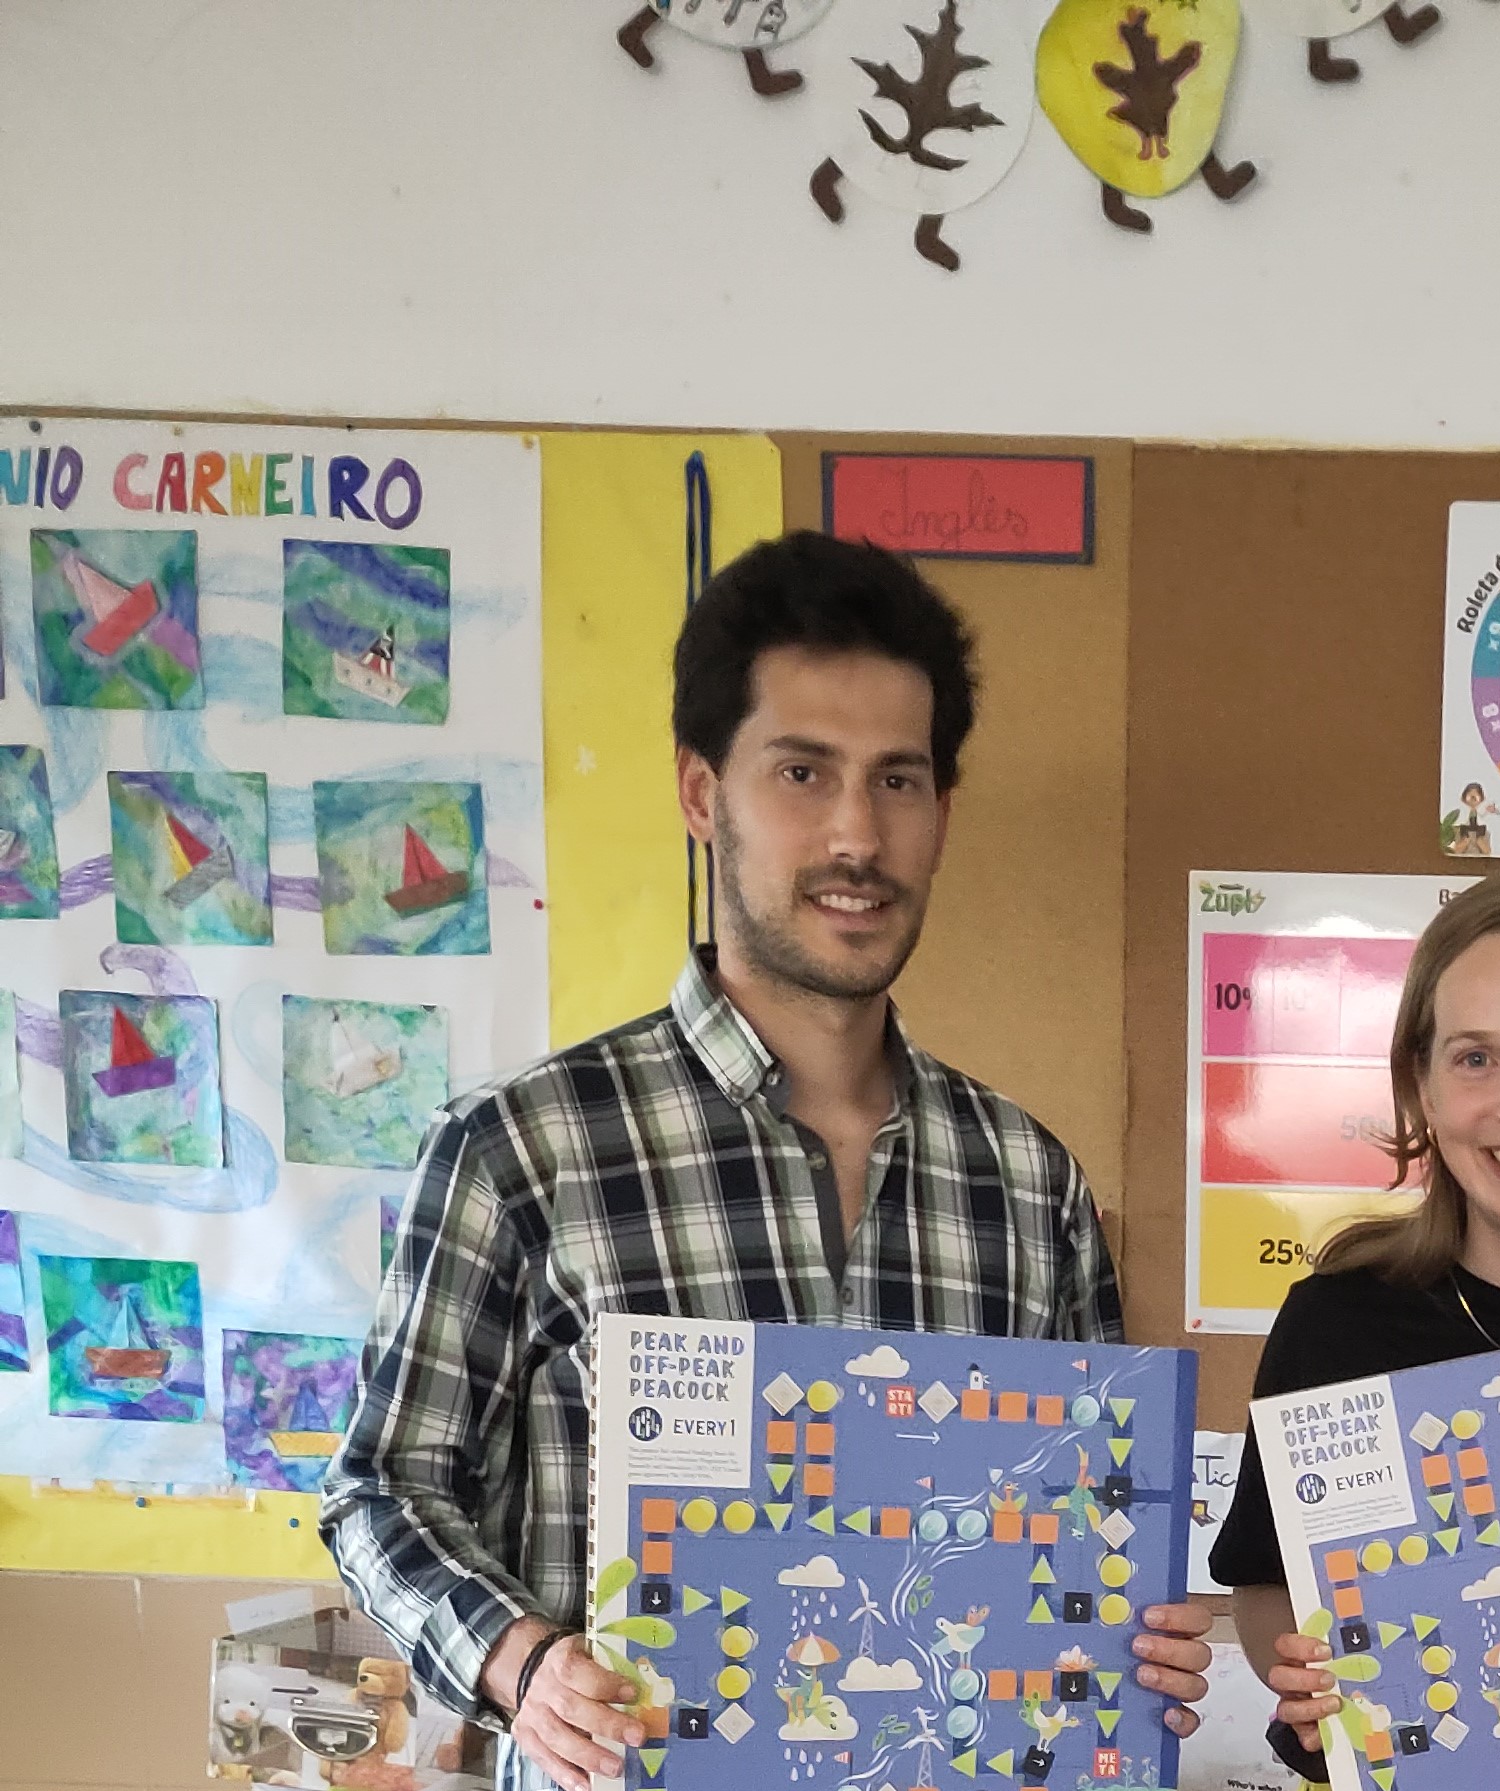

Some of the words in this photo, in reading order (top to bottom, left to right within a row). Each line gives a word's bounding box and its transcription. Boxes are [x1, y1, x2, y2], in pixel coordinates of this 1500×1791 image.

[113, 449, 422, 530] CARNEIRO
[1456, 571, 1498, 635] Roleta
[1259, 1238, 1315, 1265] 25%
[630, 1330, 687, 1353] PEAK
[698, 1334, 745, 1356] AND
[629, 1355, 735, 1379] OFF-PEAK
[629, 1378, 730, 1402] PEACOCK
[1280, 1397, 1333, 1427] PEAK
[1342, 1391, 1385, 1418] AND
[1284, 1415, 1381, 1447] OFF-PEAK
[1289, 1436, 1381, 1468] PEACOCK
